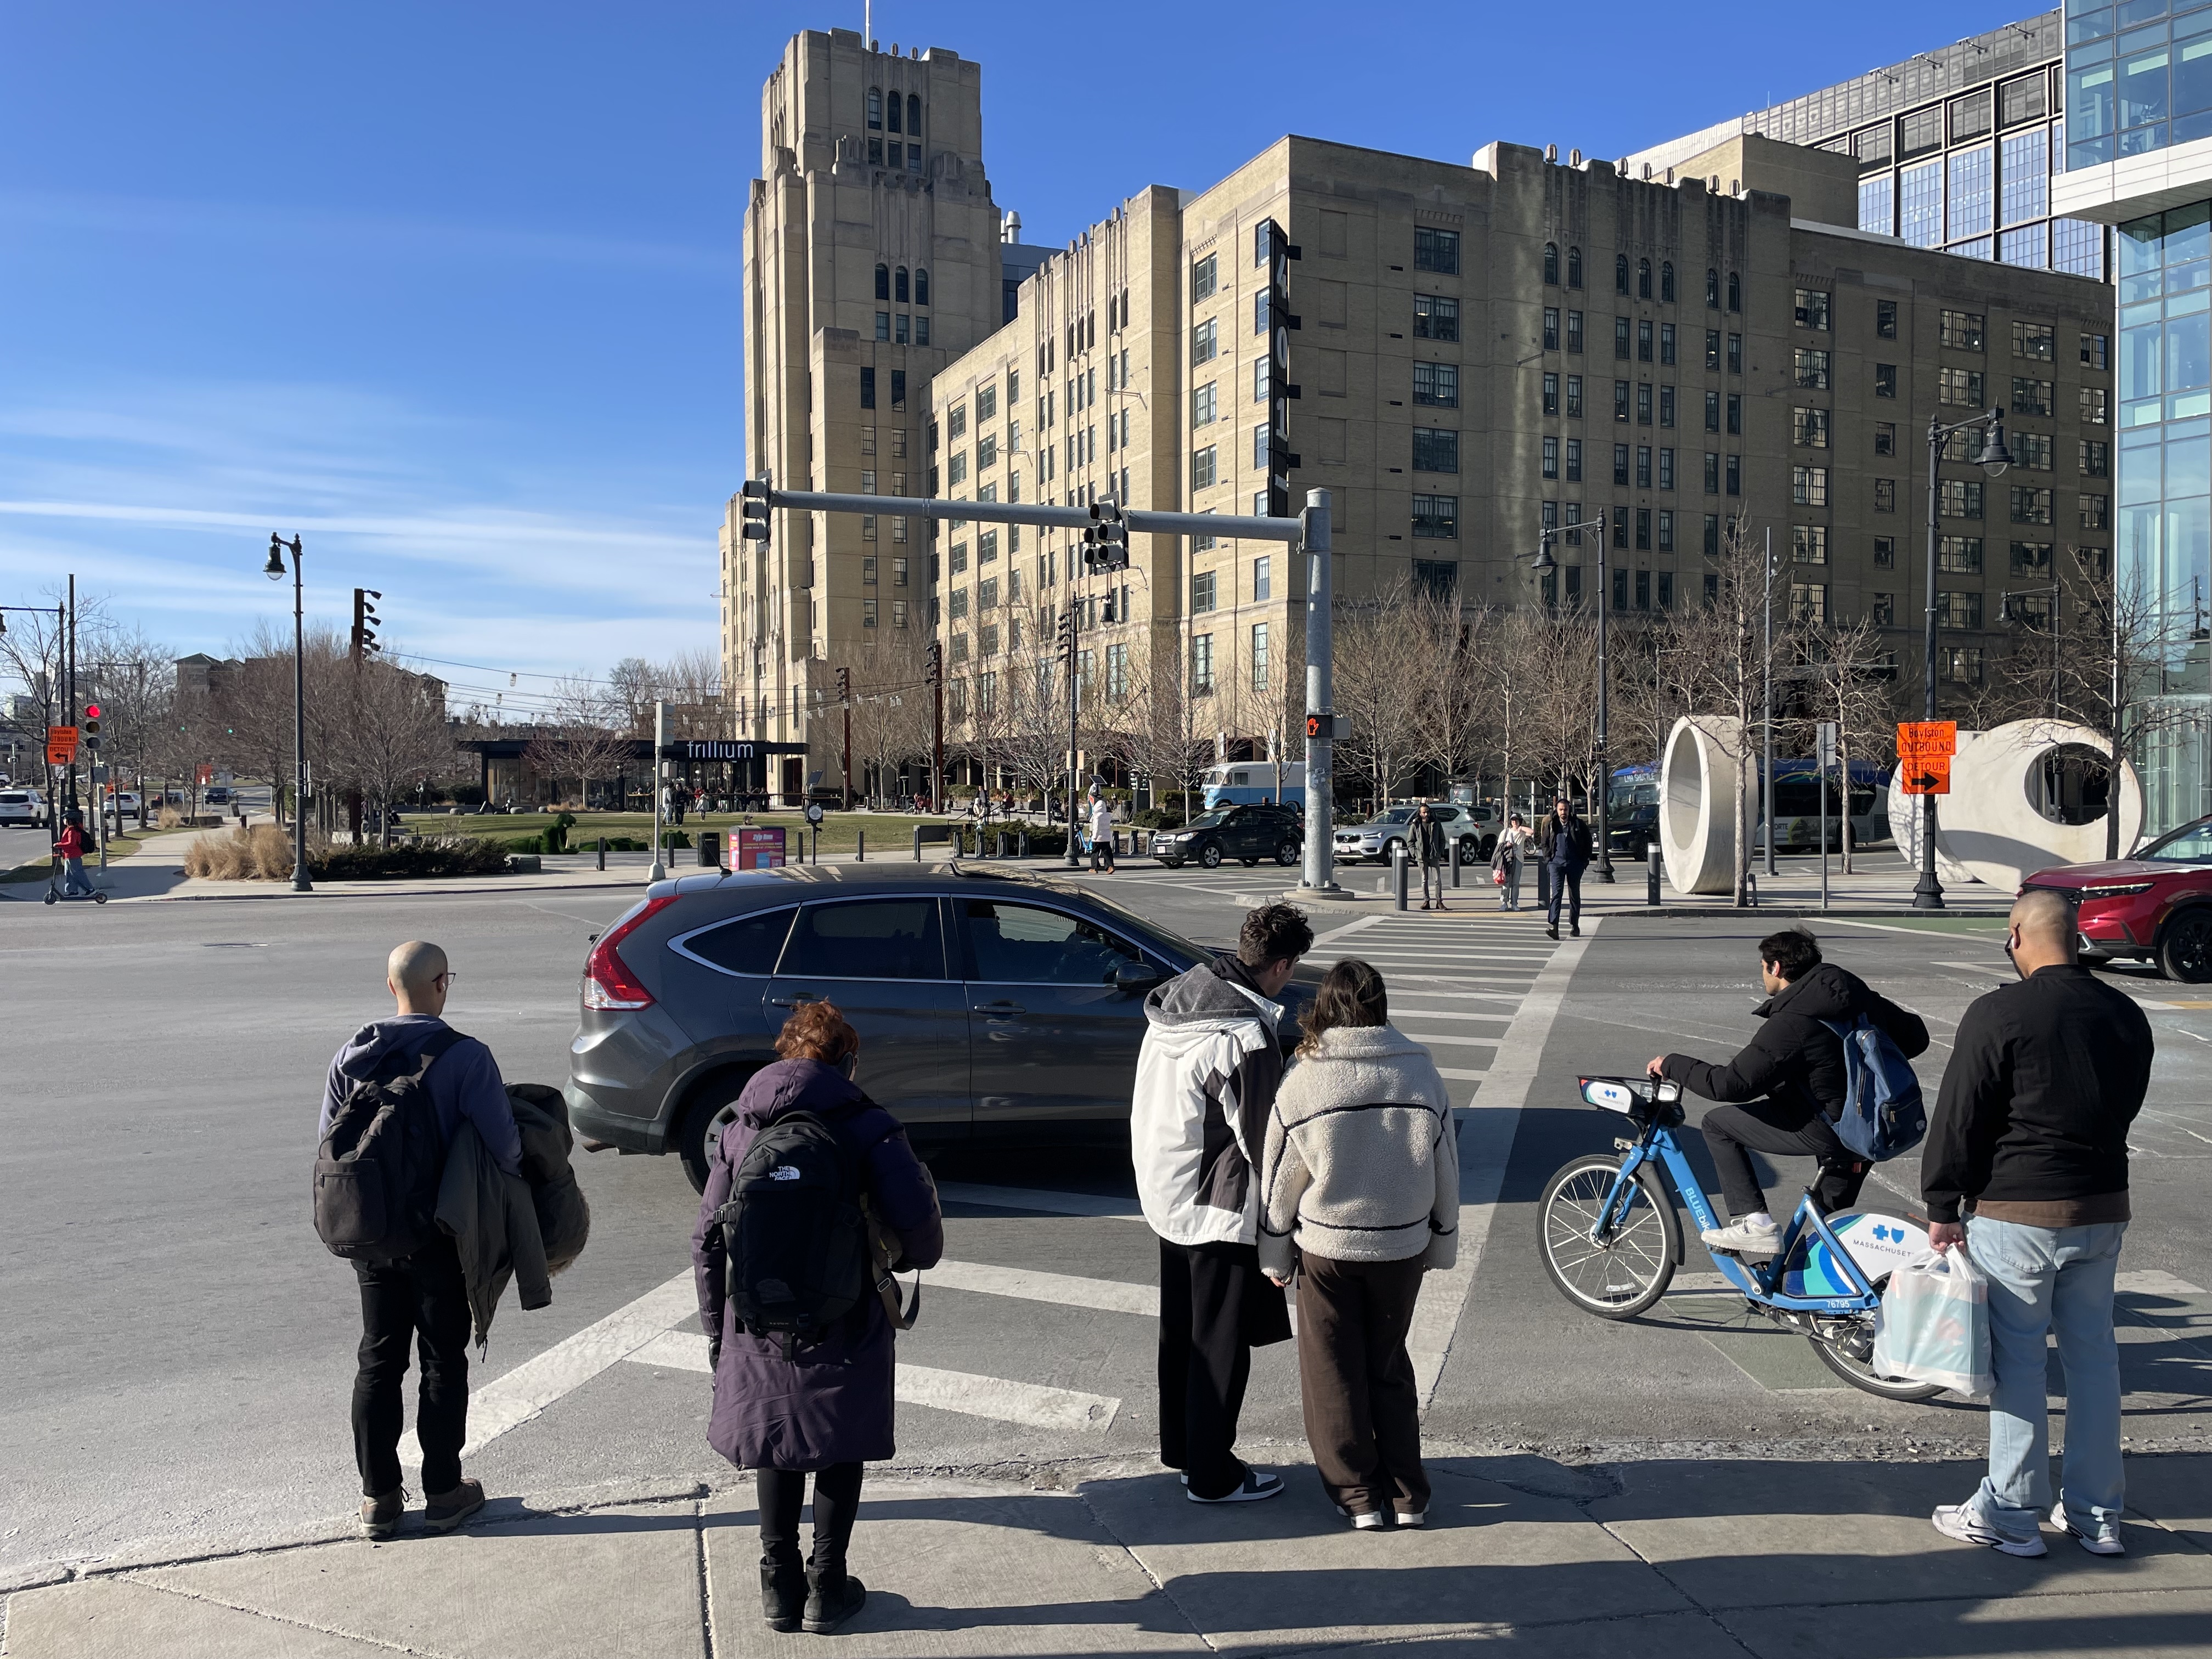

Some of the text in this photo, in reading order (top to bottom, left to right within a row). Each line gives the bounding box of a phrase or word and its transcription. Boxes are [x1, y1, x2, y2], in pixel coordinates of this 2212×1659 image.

[1909, 727, 1944, 740] Boylston
[687, 741, 753, 758] trillium
[1902, 741, 1951, 753] OUTBOUND
[1908, 762, 1945, 771] DETOUR
[1624, 775, 1634, 783] LMA
[1685, 1187, 1711, 1232] BLUEbik
[1853, 1239, 1914, 1257] MASSACHUSET
[1826, 1299, 1850, 1308] 76795
